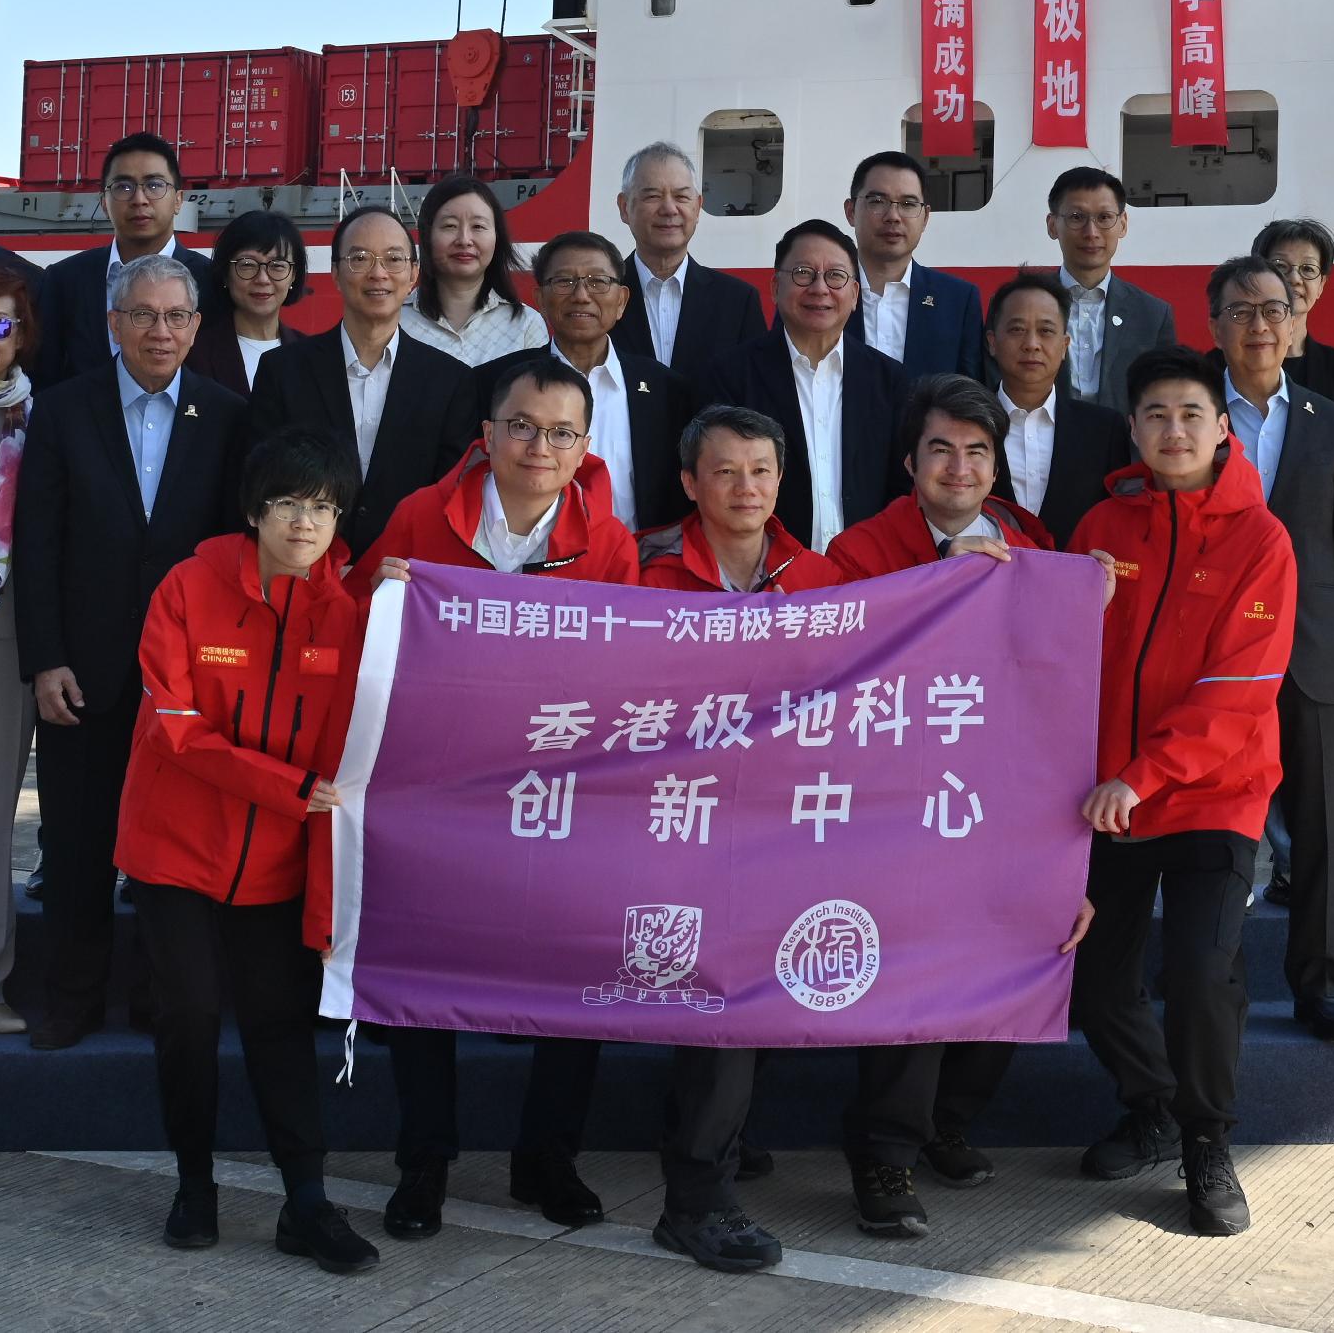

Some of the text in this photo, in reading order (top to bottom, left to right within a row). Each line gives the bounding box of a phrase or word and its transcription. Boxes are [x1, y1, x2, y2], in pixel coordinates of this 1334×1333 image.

[341, 89, 355, 101] 153
[41, 101, 53, 114] 154
[517, 185, 537, 201] P4
[22, 198, 38, 211] P1
[437, 595, 868, 644] 中国第四十一次南极考察队
[1244, 612, 1274, 620] TOREAD
[201, 654, 237, 664] CHINARE
[526, 672, 987, 754] 香港极地科学
[506, 768, 985, 846] 创新中心
[779, 903, 877, 989] Polar Research Institute of China
[808, 993, 846, 1007] 1989
